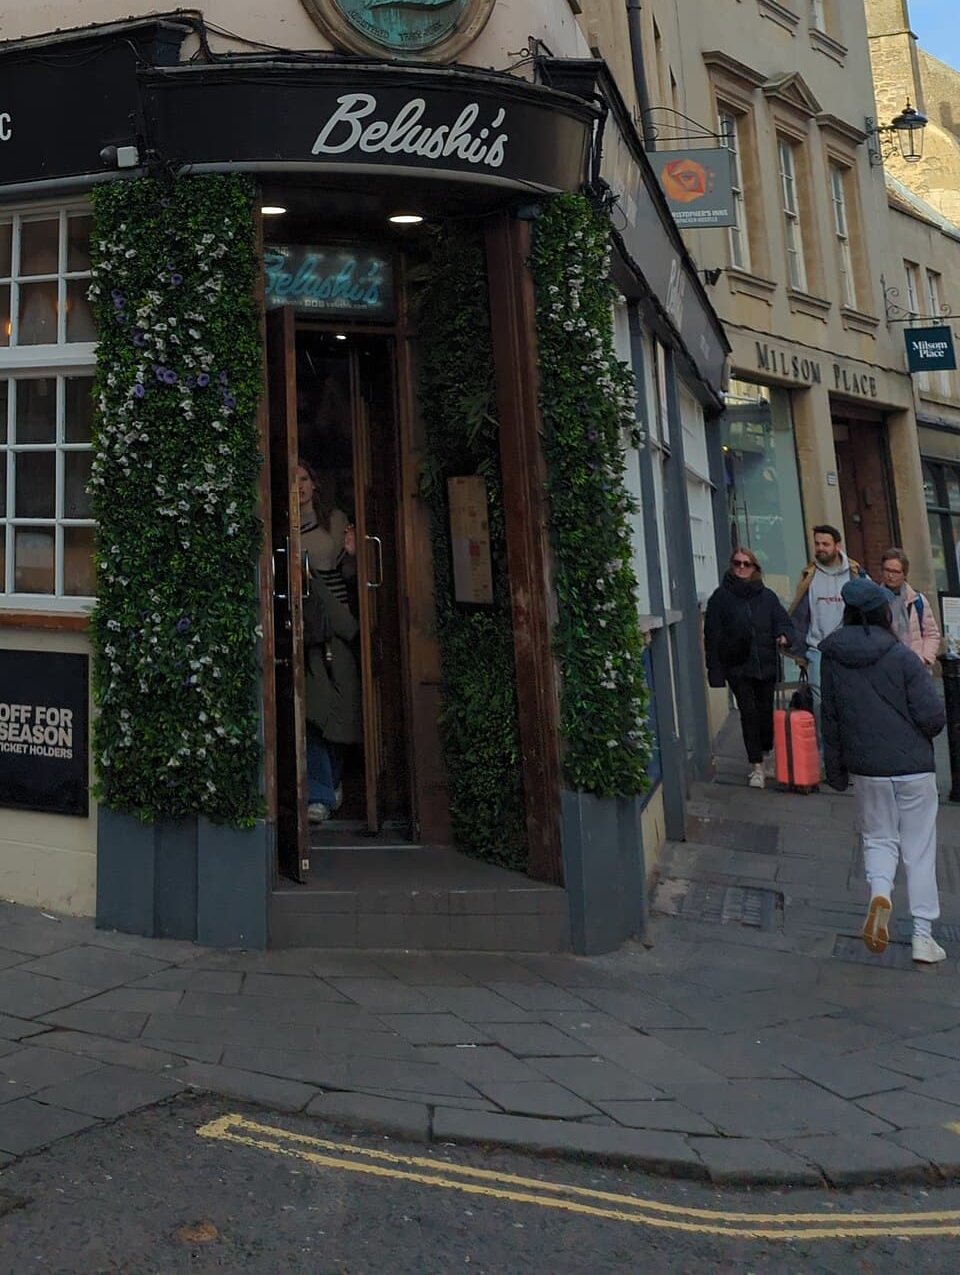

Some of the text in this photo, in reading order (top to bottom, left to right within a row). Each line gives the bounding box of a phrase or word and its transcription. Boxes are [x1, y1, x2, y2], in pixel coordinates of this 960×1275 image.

[311, 93, 508, 167] Belushi's
[912, 340, 948, 350] Milsom
[920, 349, 945, 358] Place
[755, 341, 822, 384] MILSOM
[833, 363, 877, 397] PLACE
[35, 706, 73, 727] FOR
[29, 745, 73, 759] HOLDERS
